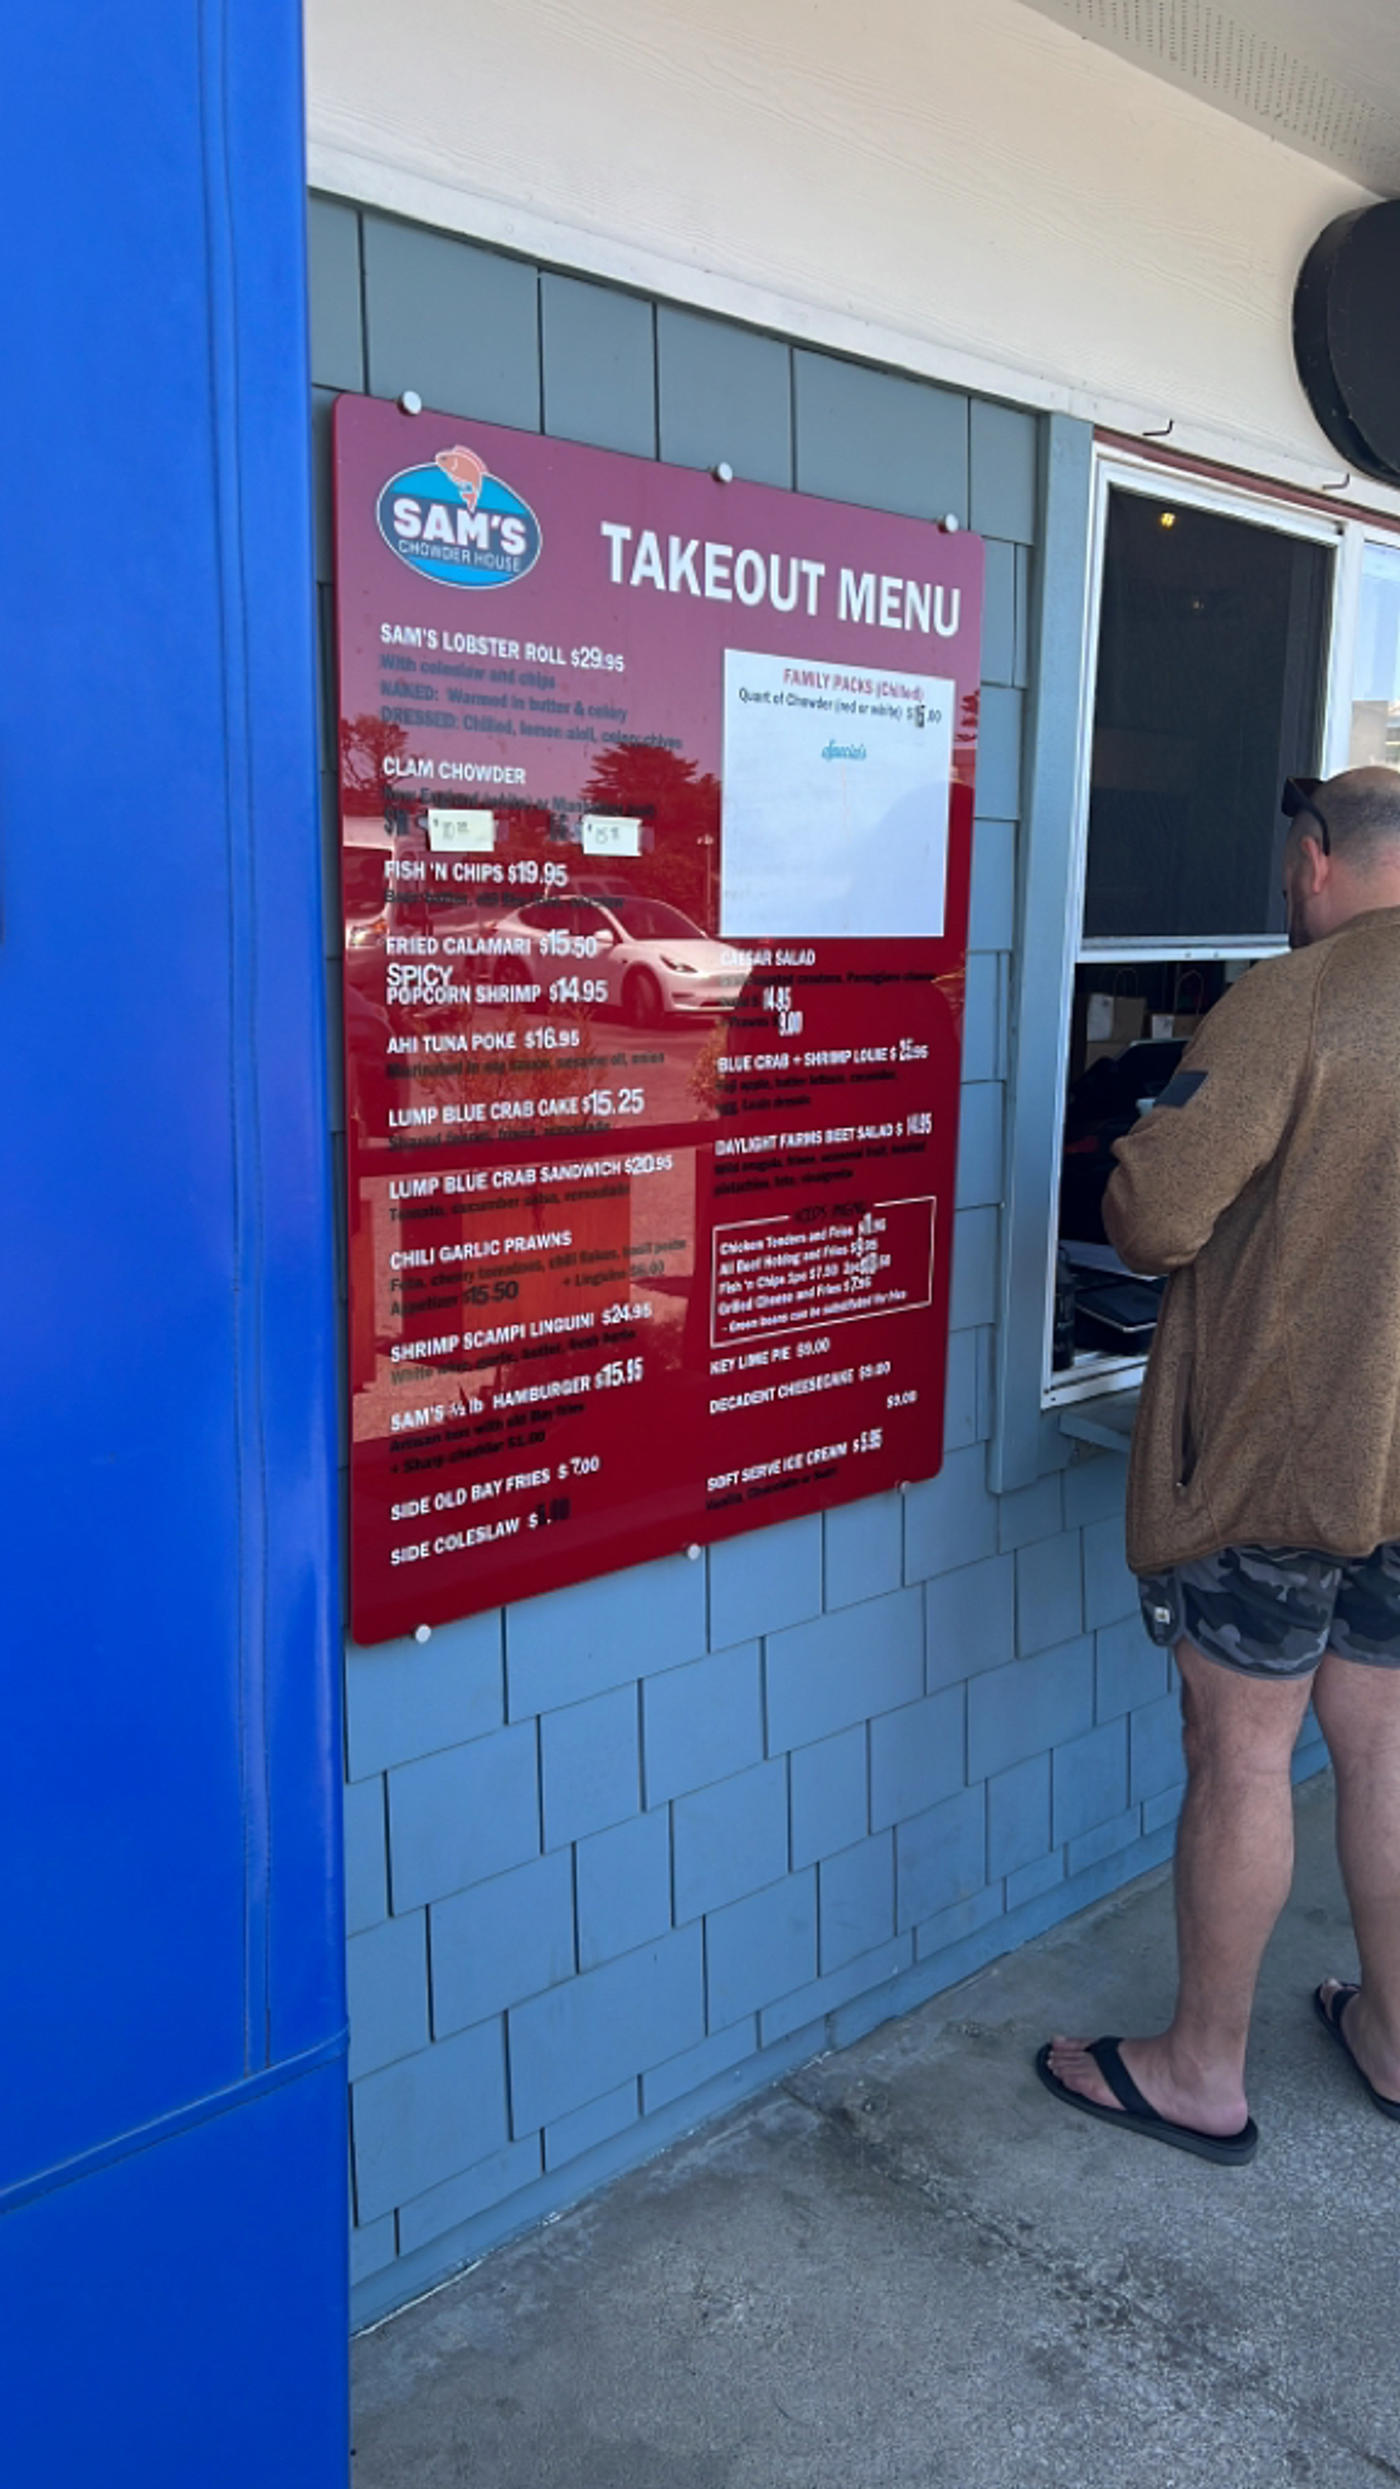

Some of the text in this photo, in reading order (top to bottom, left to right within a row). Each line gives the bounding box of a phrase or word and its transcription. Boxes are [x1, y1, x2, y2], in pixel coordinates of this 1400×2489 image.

[394, 498, 526, 555] SAM'S
[399, 539, 521, 572] CHOWDER HOUSE
[601, 521, 960, 637] TAKEOUT MENU
[380, 623, 624, 672] SAM'S LOBSTER ROLL $29.95
[783, 668, 831, 689] FAMILY
[833, 675, 873, 694] PACKS
[773, 692, 784, 704] of
[383, 756, 526, 785] CLAM CHOWDER
[384, 860, 569, 887] FISH 'N CHIPS $19.95
[386, 929, 597, 958] FRIED CALAMARI $15.50
[775, 948, 816, 966] SALAD
[386, 963, 453, 987] SPICY
[387, 977, 609, 1005] POPCORN SHRIMP $14.95
[387, 1027, 579, 1054] AHI TUNA POKE $16.95
[717, 1055, 752, 1073] BLUE
[754, 1053, 789, 1071] CRAB
[804, 1050, 851, 1068] SHRIMP
[389, 1088, 644, 1128] LUMP BLUE CRAB CAKE $15.25
[715, 1135, 778, 1156] DAYLIGHT
[780, 1130, 822, 1149] FARMS
[825, 1128, 855, 1144] BEET
[857, 1123, 893, 1141] SALAD
[389, 1180, 439, 1200] LUMP
[444, 1172, 488, 1194] BLUE
[492, 1166, 536, 1188] CRAB
[540, 1158, 621, 1182] SANDWICH
[390, 1230, 572, 1270] CHILI GARLIC PRAWNS
[390, 1337, 459, 1363] SHRIMP
[463, 1325, 526, 1351] SCAMPI
[530, 1313, 594, 1338] LINGUINI
[710, 1358, 735, 1375] KEY
[738, 1351, 769, 1370] LIME
[771, 1347, 791, 1362] PIE
[391, 1405, 445, 1432] SAM'S
[470, 1401, 483, 1414] lb
[493, 1375, 591, 1409] HAMBURGER
[710, 1387, 775, 1415] DECADENT
[778, 1368, 854, 1398] CHEESECAKE
[707, 1472, 739, 1492] SOFT
[741, 1459, 781, 1482] SERVE
[783, 1454, 804, 1472] ICE
[806, 1442, 847, 1466] CREAM
[391, 1497, 430, 1520] SIDE
[434, 1488, 467, 1510] OLD
[471, 1479, 502, 1502] BAY
[506, 1467, 550, 1492] FRIES
[391, 1516, 520, 1566] SIDE COLESLAW
